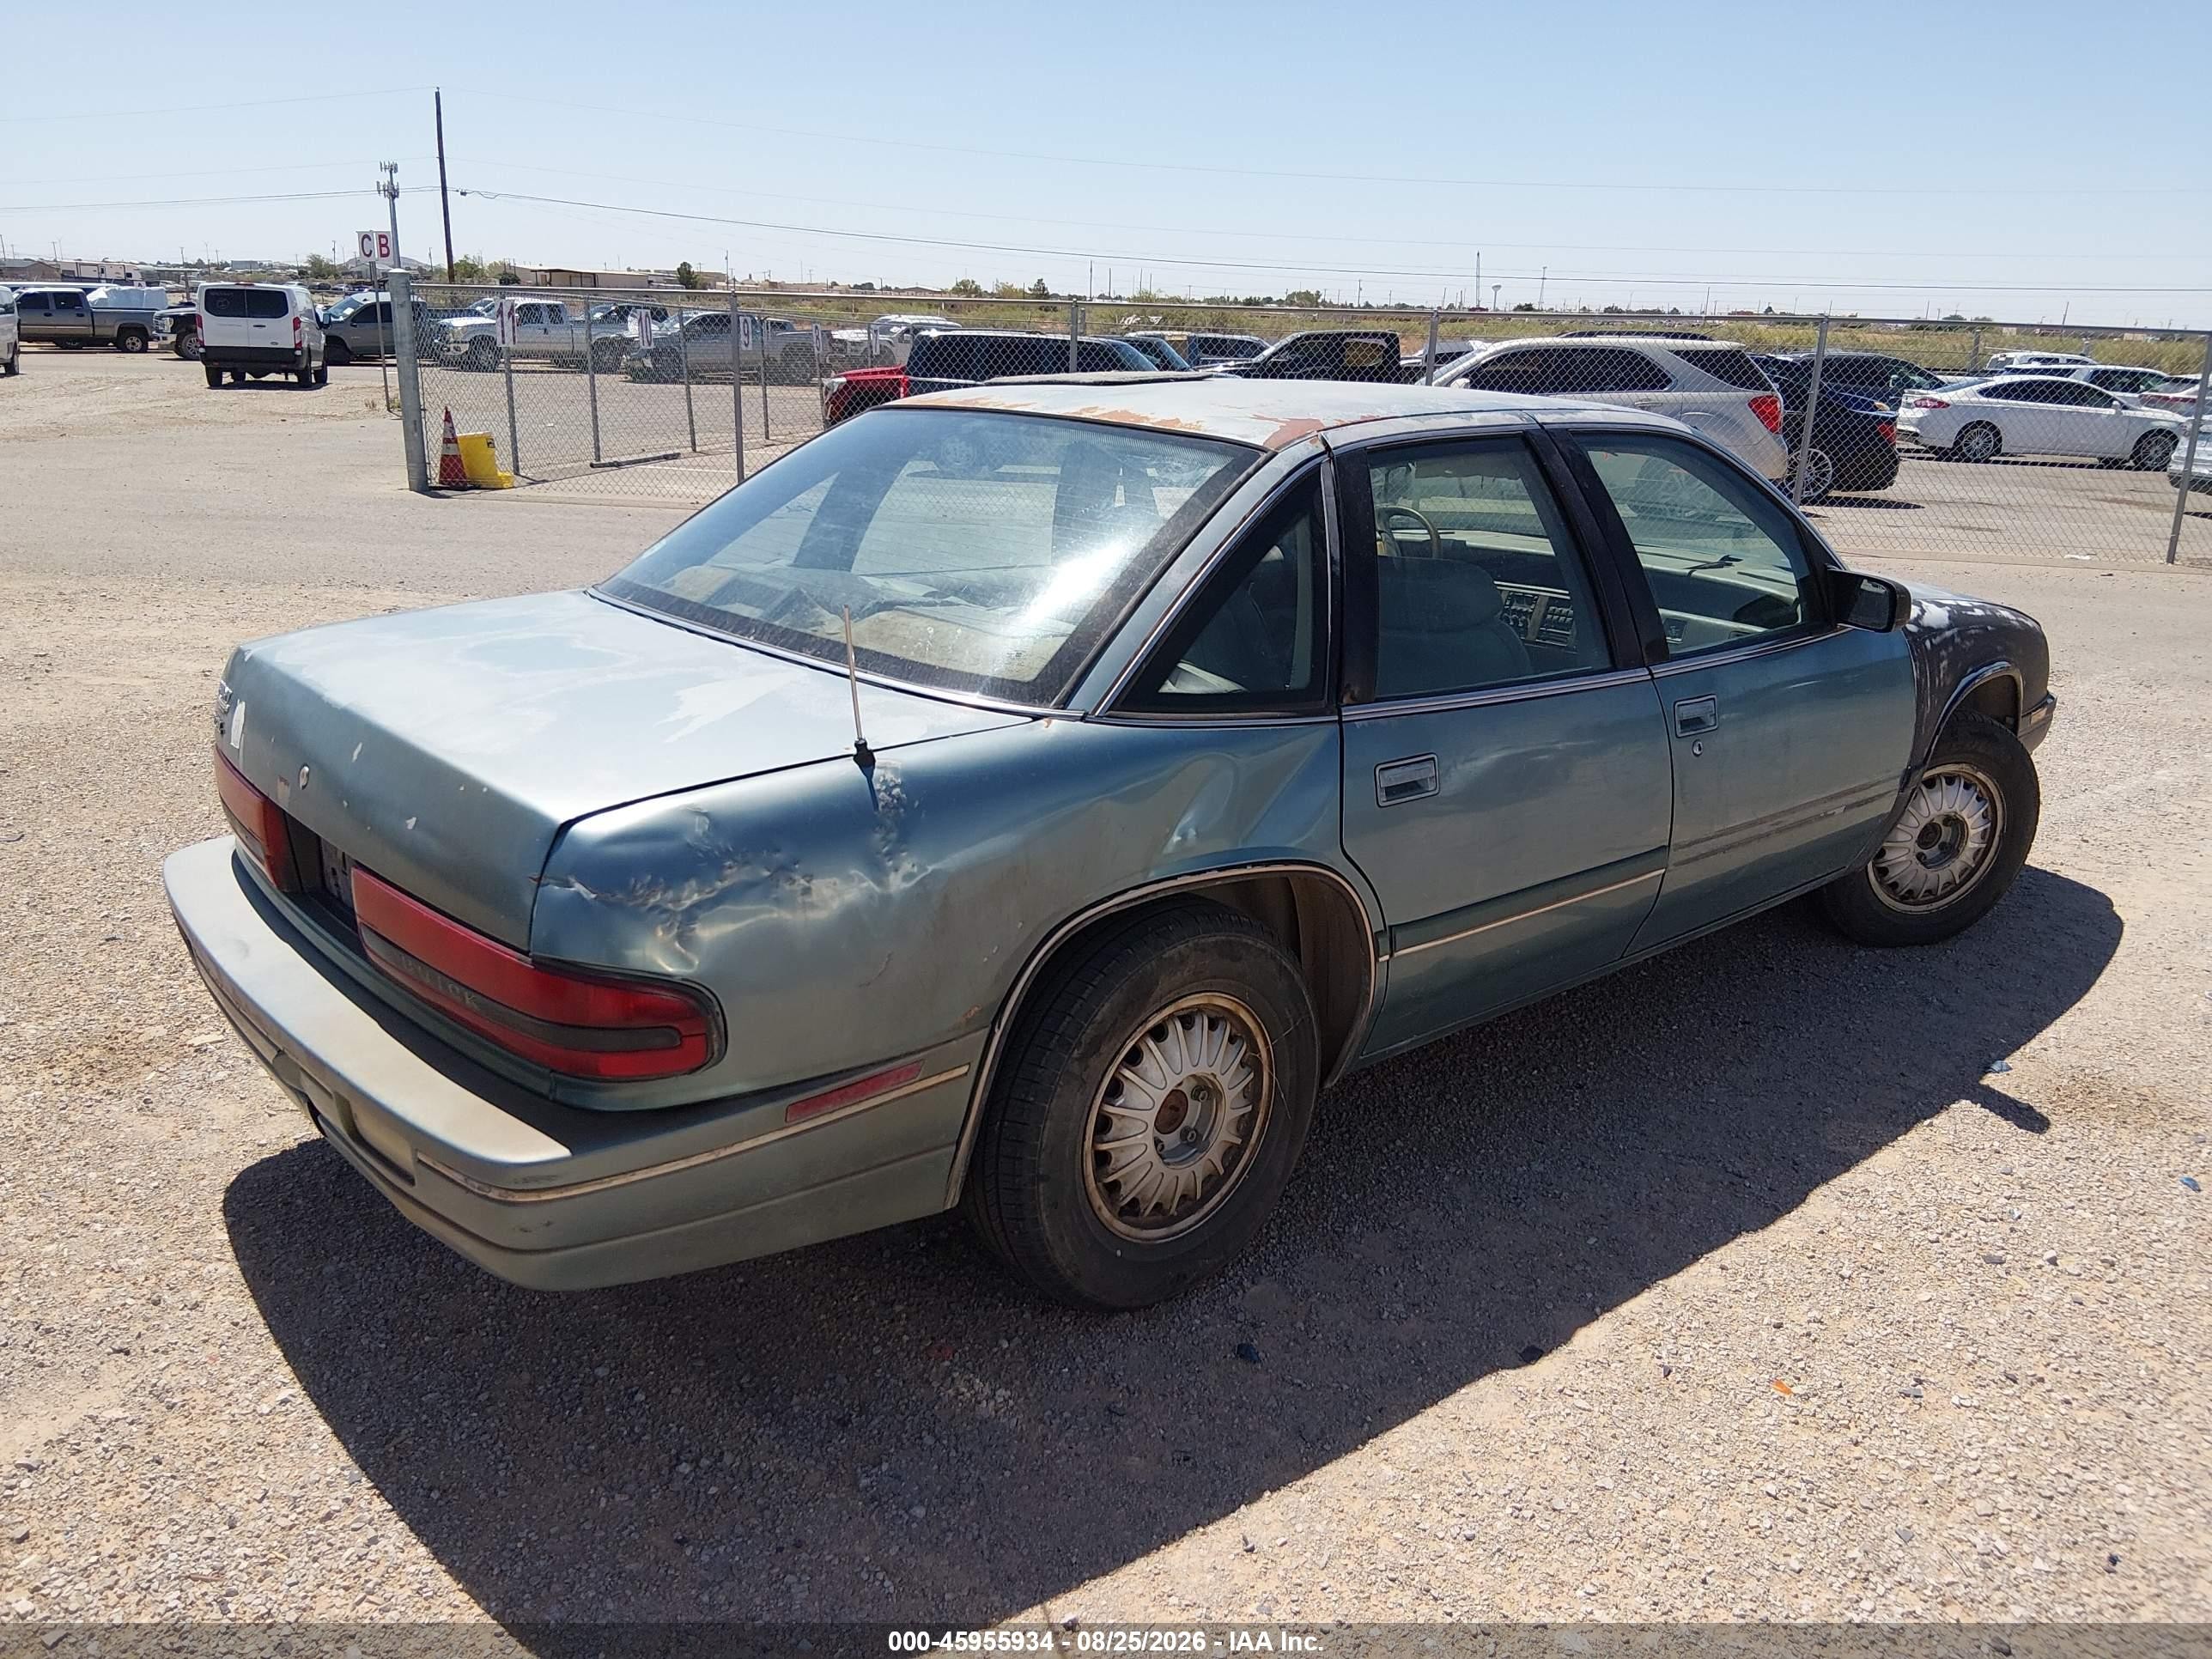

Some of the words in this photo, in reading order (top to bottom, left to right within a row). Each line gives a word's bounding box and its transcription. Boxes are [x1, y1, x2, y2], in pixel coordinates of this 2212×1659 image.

[362, 234, 373, 258] C
[378, 234, 391, 258] B
[496, 301, 517, 345] 11
[638, 311, 652, 347] 10
[743, 319, 750, 347] 9
